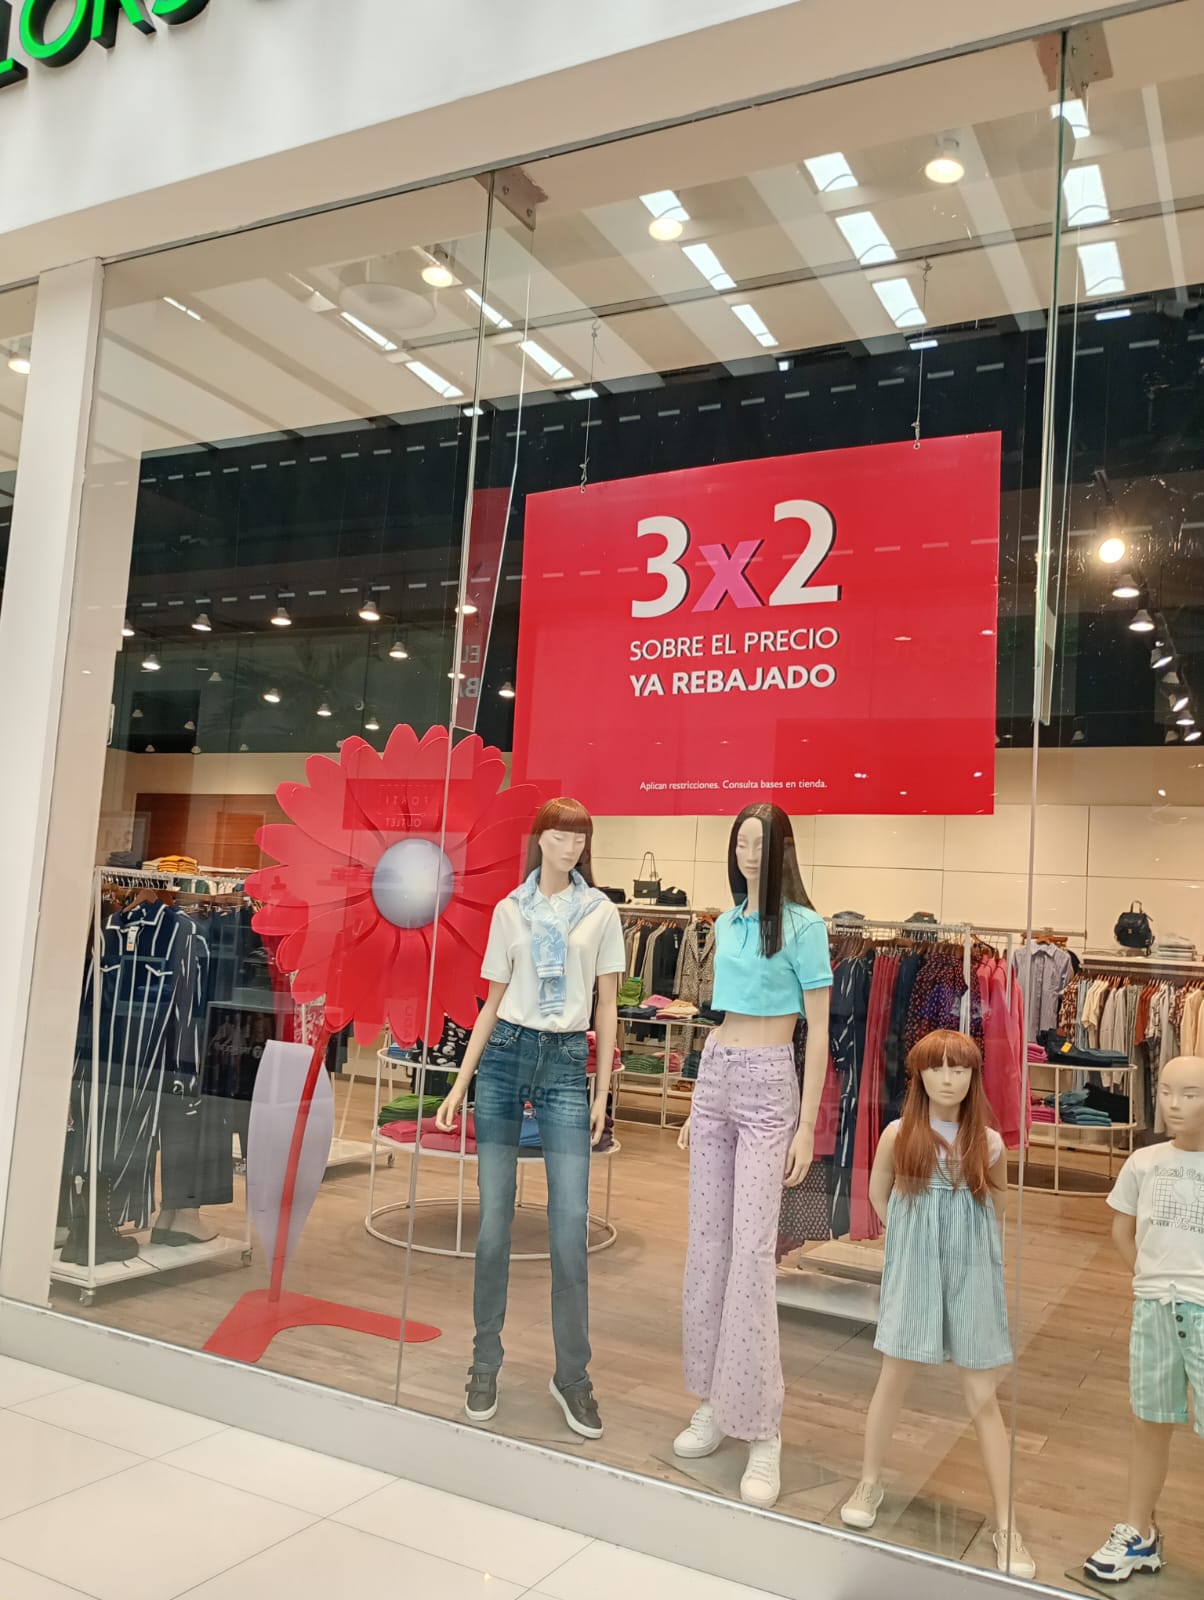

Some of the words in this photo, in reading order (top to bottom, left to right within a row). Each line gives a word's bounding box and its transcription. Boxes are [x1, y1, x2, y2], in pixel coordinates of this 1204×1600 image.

[631, 499, 842, 617] 3x2
[629, 635, 705, 662] SOBRE
[711, 633, 737, 655] EL
[744, 627, 840, 653] PRECIO
[629, 674, 665, 697] YA
[672, 663, 838, 694] REBAJADO
[639, 780, 667, 791] Aplican
[669, 780, 720, 790] restricciones.
[722, 779, 759, 789] Consulta
[760, 779, 784, 789] bases
[785, 781, 797, 789] en
[798, 778, 828, 789] tienda.
